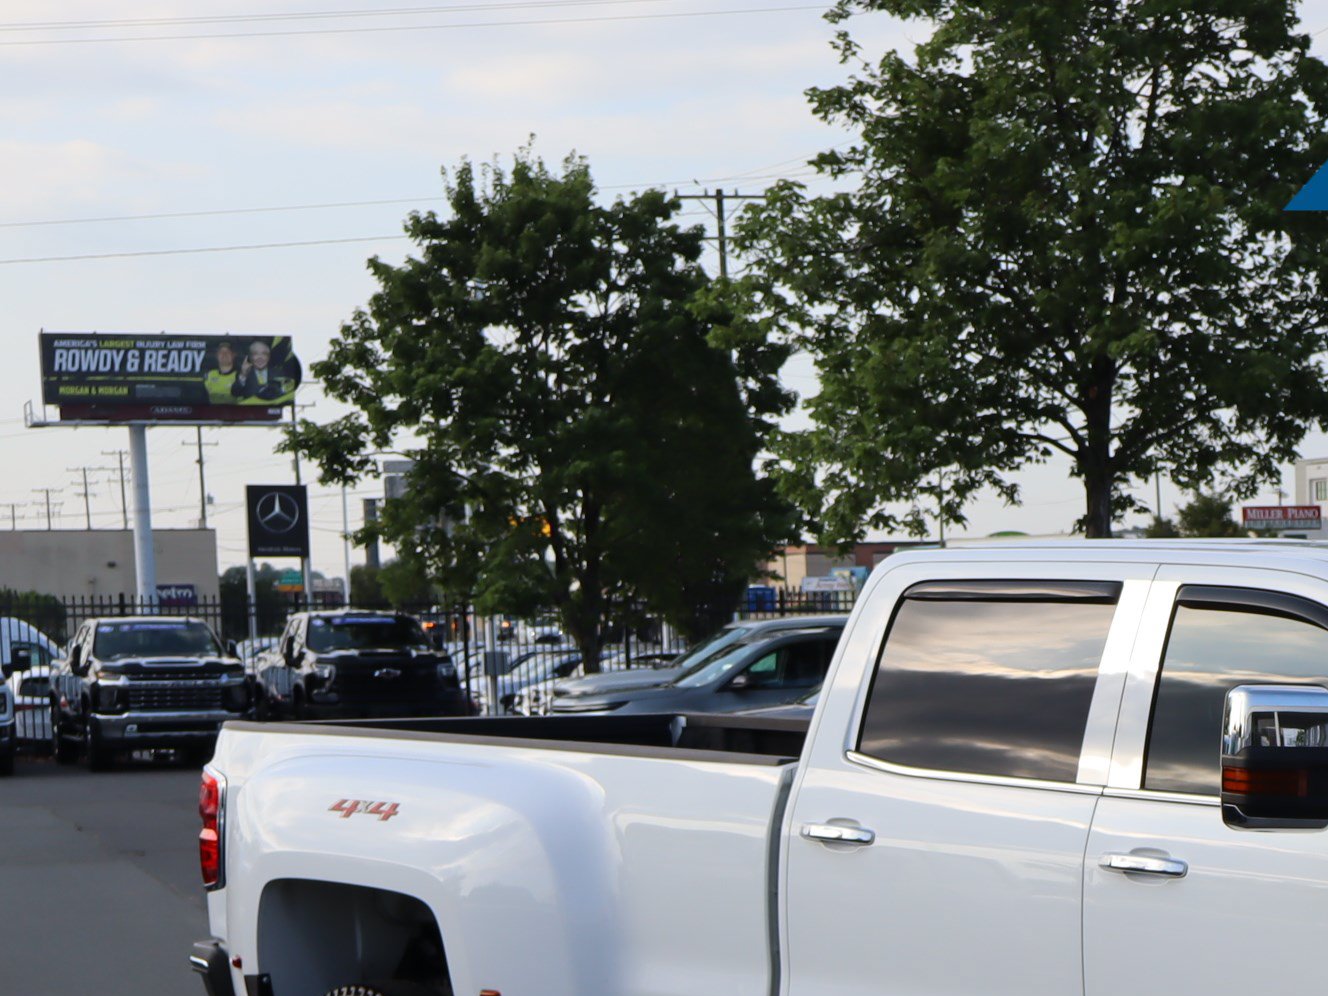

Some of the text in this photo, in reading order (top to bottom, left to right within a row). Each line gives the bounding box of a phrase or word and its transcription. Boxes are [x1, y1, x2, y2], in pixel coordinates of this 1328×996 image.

[53, 349, 206, 373] ROWDY & READY
[59, 385, 90, 396] MORGAN
[98, 386, 129, 396] MORGAN
[1246, 508, 1319, 520] MILLER PIANO
